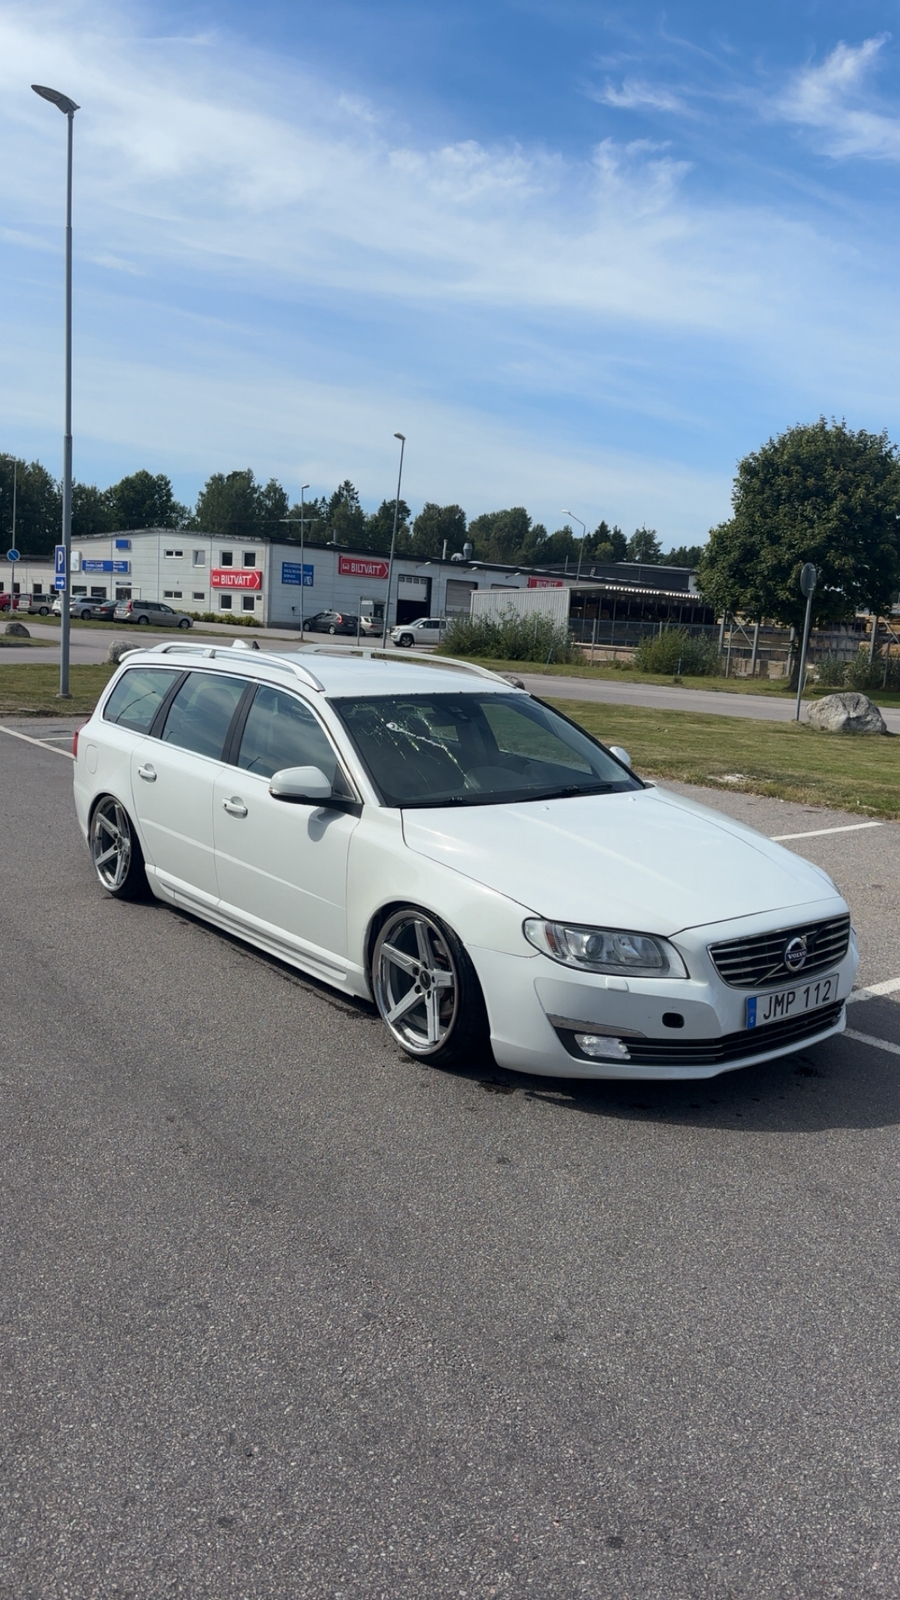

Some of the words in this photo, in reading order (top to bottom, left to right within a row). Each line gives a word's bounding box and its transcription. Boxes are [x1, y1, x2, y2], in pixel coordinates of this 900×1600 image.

[57, 551, 64, 572] P
[350, 563, 382, 575] BILTVÄTT
[220, 573, 252, 585] BILTVÄTT
[787, 951, 806, 959] VOLVO
[763, 991, 796, 1020] JMP
[803, 979, 832, 1008] 112
